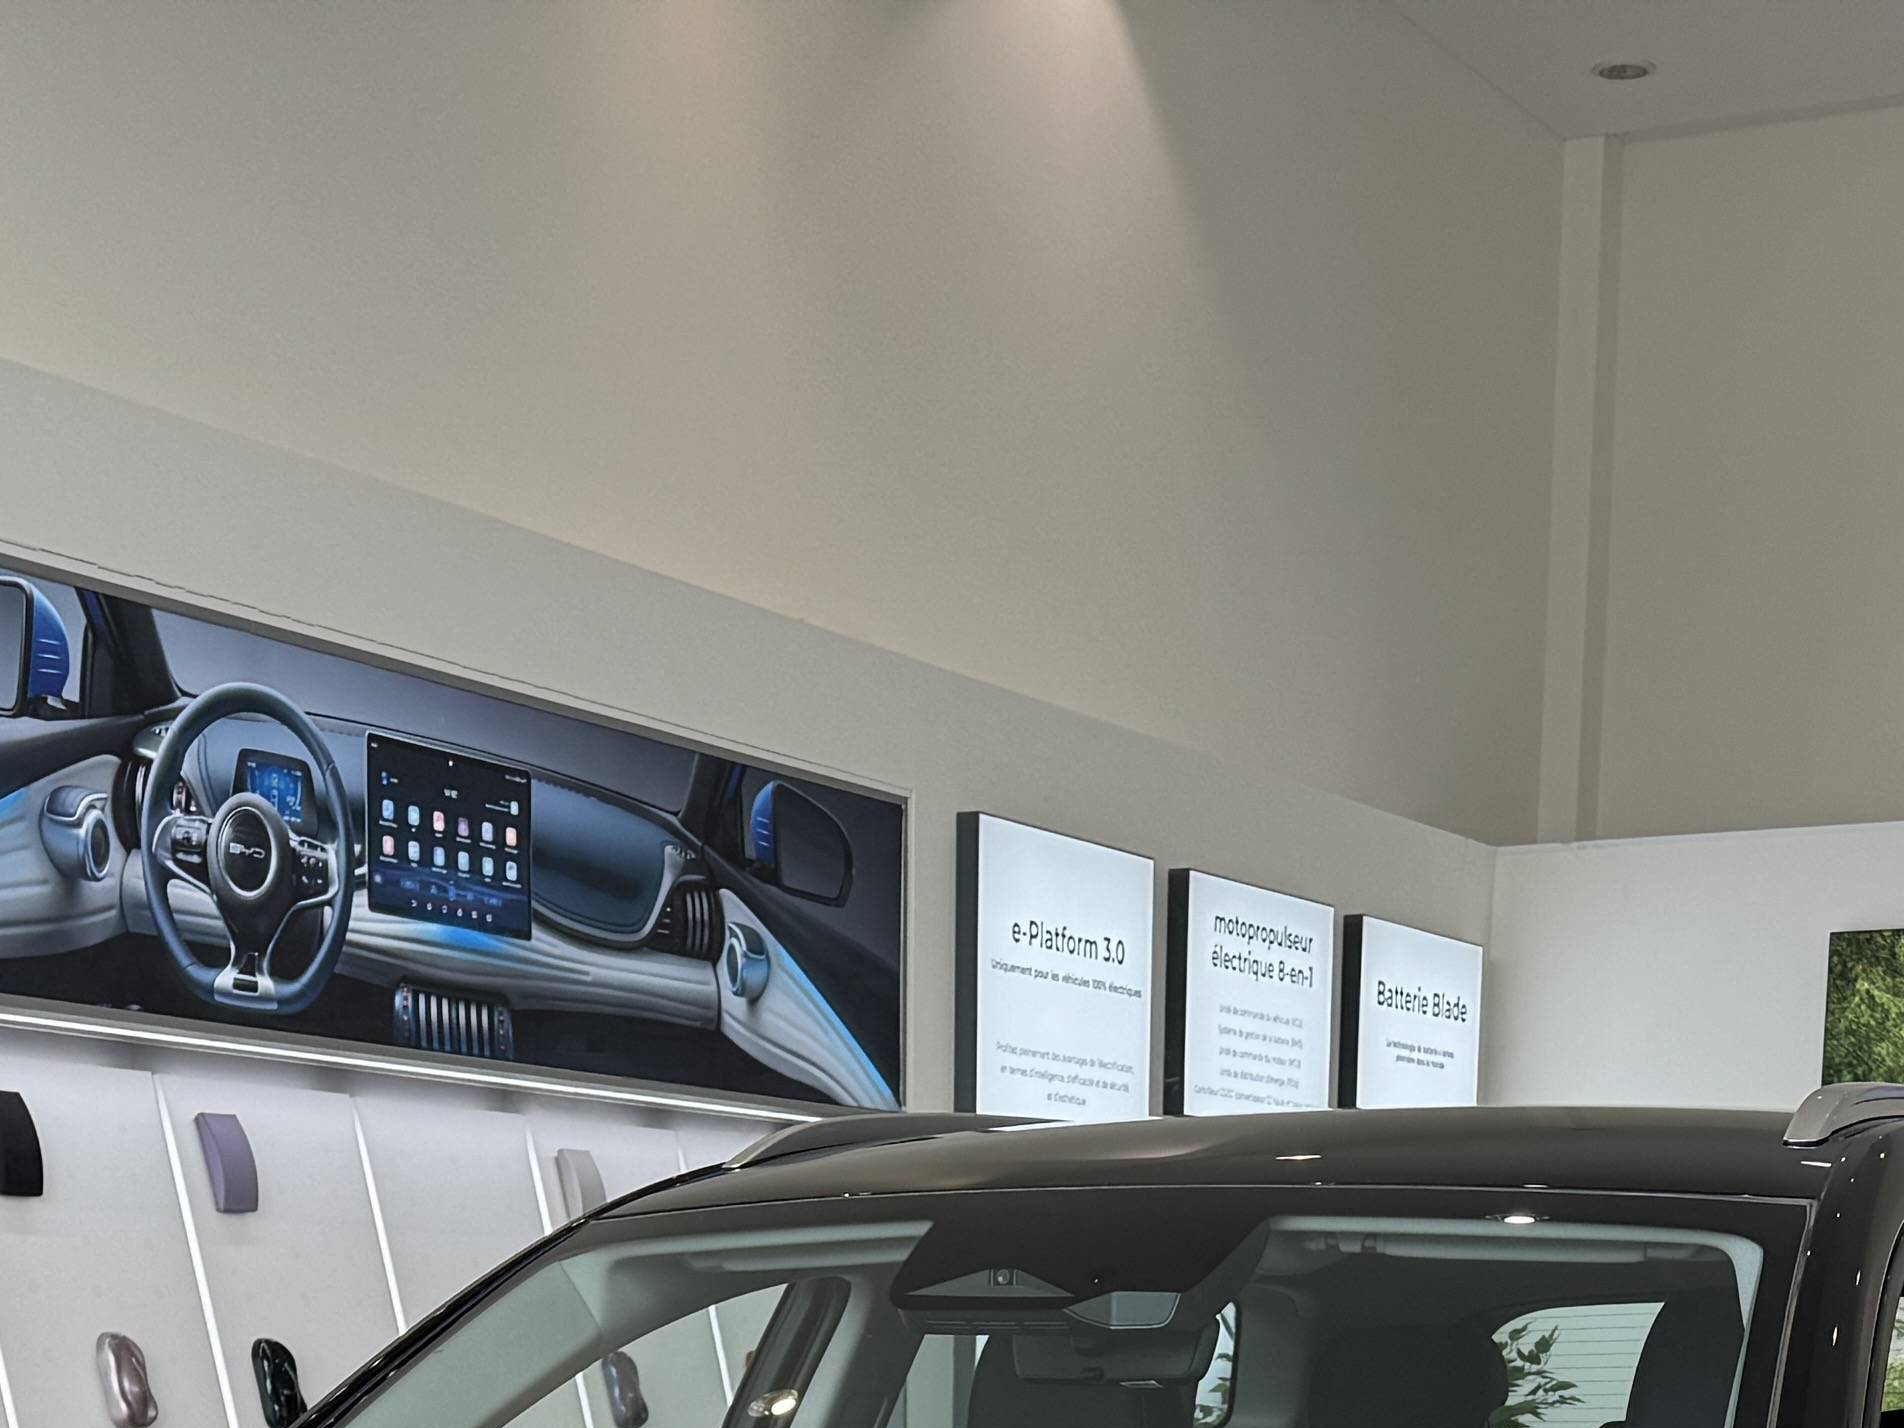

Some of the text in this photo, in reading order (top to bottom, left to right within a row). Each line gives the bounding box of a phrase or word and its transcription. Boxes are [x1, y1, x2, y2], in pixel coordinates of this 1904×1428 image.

[1011, 919, 1126, 966] e-Platform 3.0
[1213, 914, 1314, 954] motopropulseur
[1211, 943, 1314, 989] électrique 8-en-1
[1376, 980, 1468, 1024] Batterie Blade
